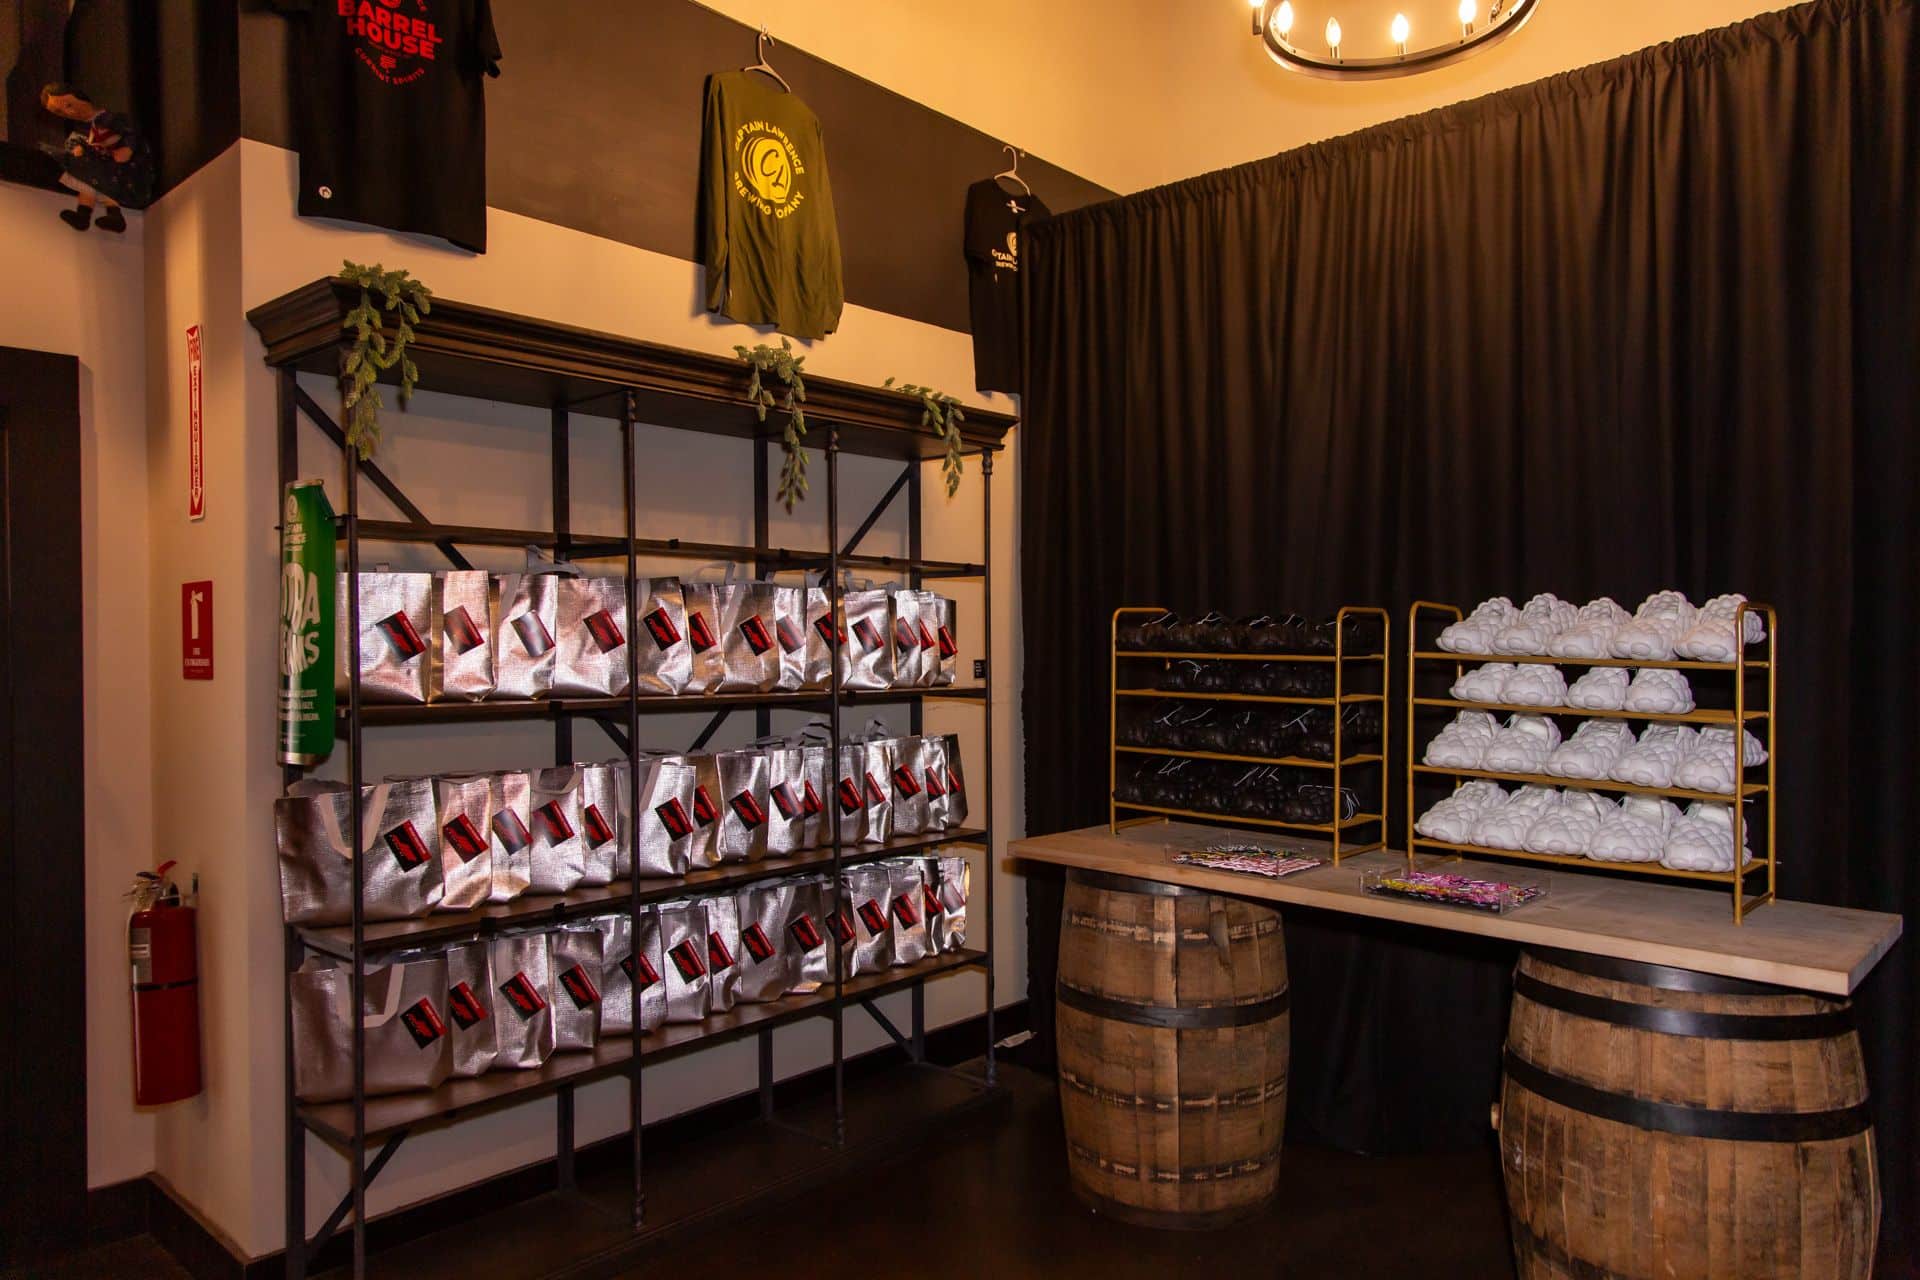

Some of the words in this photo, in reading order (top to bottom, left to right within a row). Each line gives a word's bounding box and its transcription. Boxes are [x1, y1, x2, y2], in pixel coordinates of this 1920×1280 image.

[337, 0, 443, 43] BARREL
[346, 17, 435, 61] HOUSE
[765, 122, 805, 175] LAWRENCE
